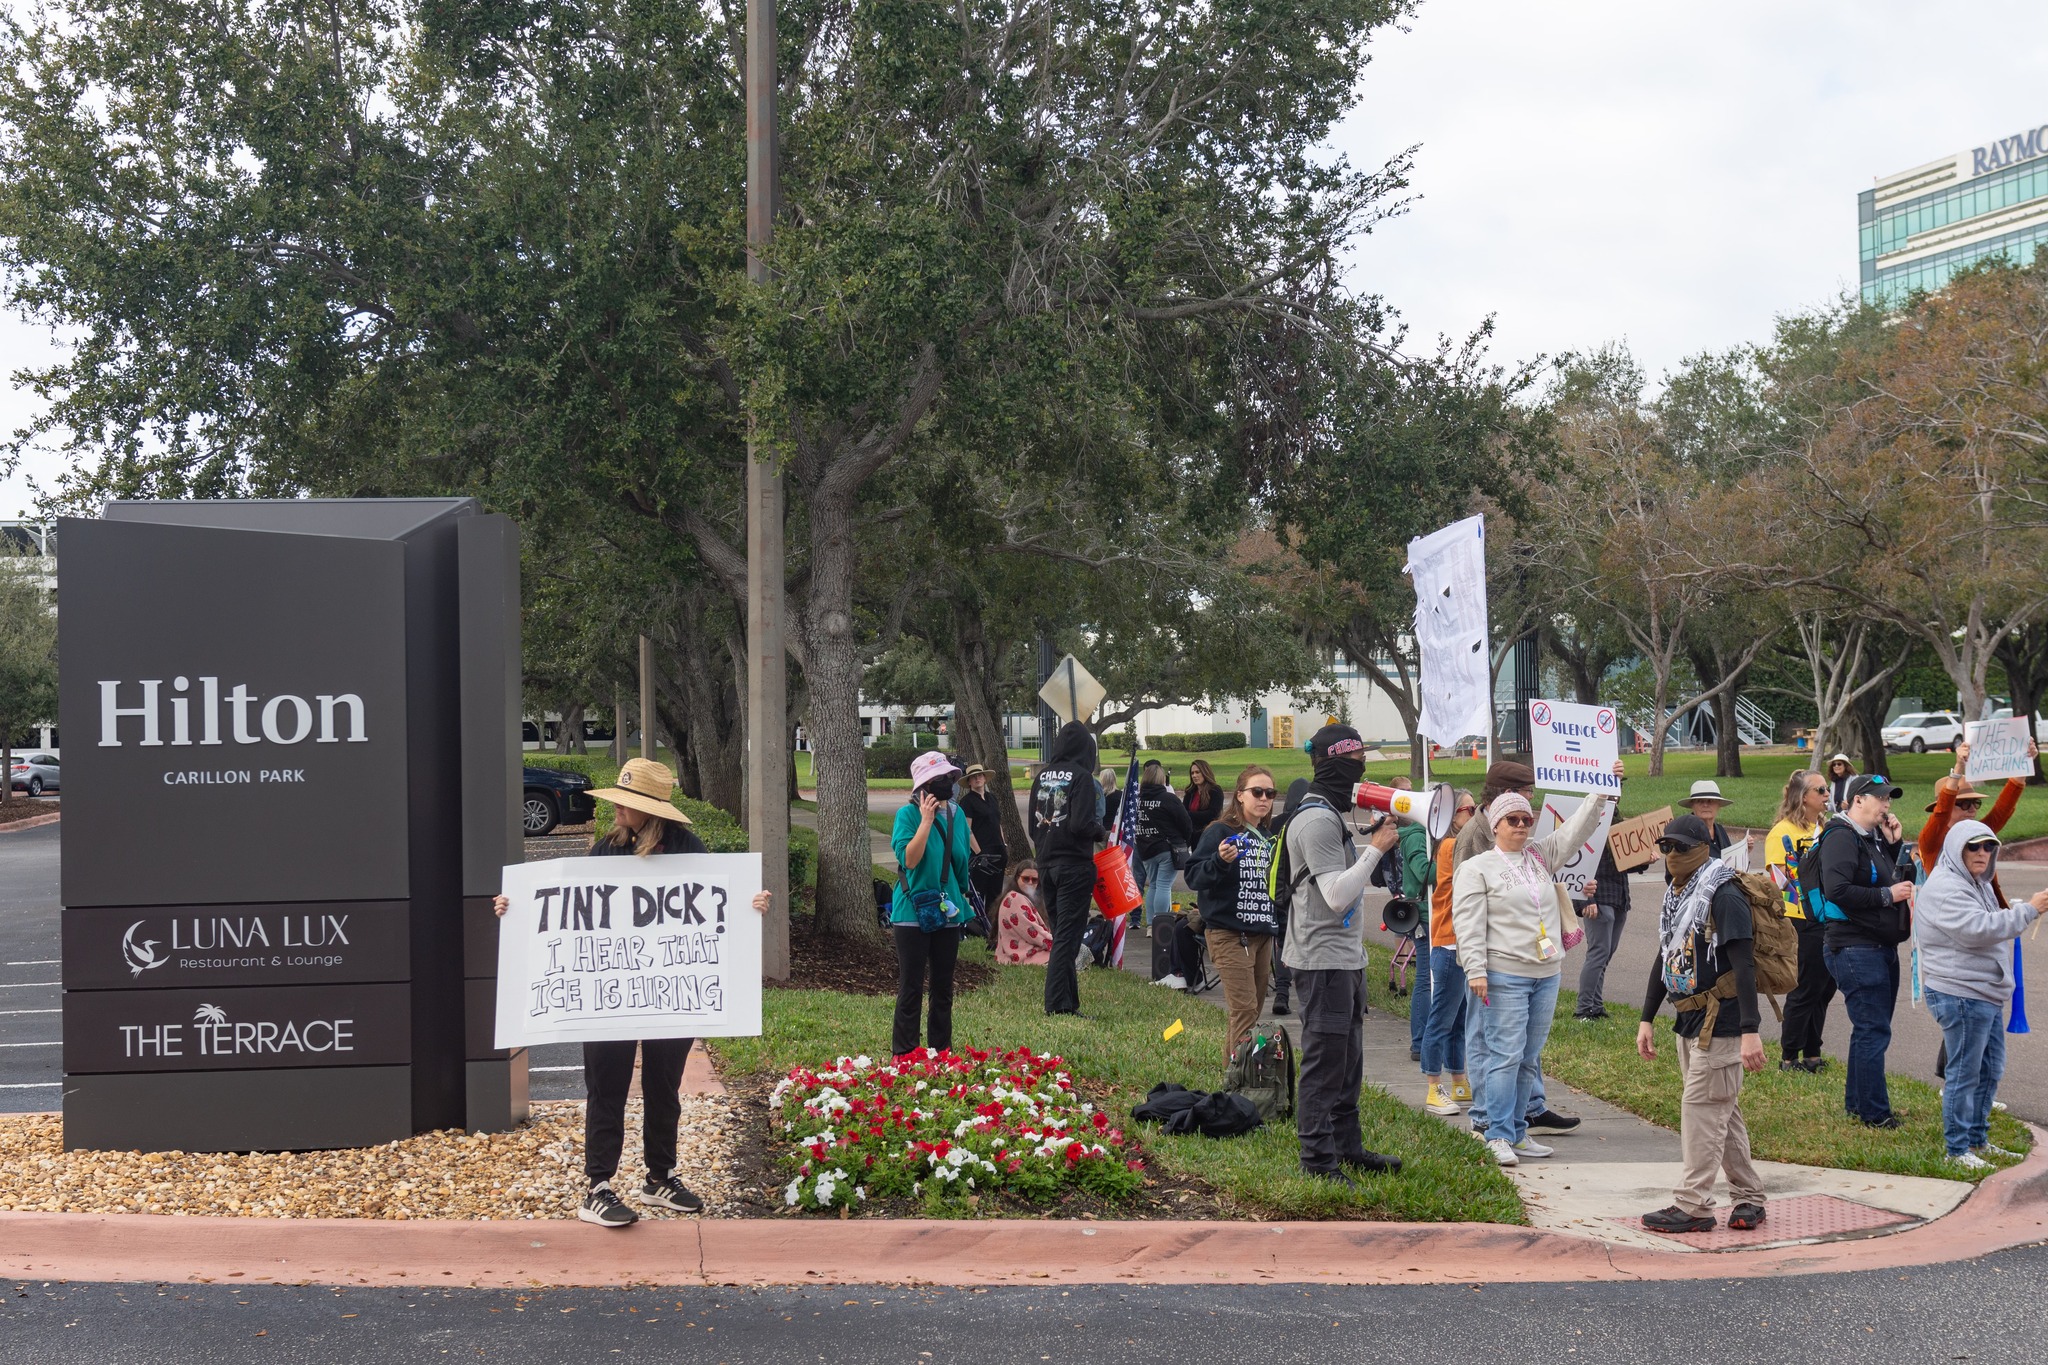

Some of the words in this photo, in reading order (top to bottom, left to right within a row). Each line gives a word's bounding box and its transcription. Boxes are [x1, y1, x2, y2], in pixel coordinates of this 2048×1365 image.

[97, 676, 369, 747] Hilton
[1551, 721, 1598, 739] SILENCE
[1970, 722, 2010, 744] THE
[1327, 738, 1363, 757] CHICAGO
[1970, 736, 2019, 764] WORLD
[1554, 754, 1600, 768] COMPLIANCE
[1970, 755, 2030, 777] WATCHING
[163, 770, 251, 785] CARILLON
[260, 769, 306, 783] PARK
[1039, 770, 1073, 782] CHAOS
[1537, 766, 1572, 783] FIGHT
[1574, 769, 1620, 788] FASCIST
[1611, 828, 1650, 860] FUCK
[1648, 818, 1674, 846] NAZ
[1240, 881, 1258, 891] you
[534, 884, 619, 934] TINY
[632, 882, 728, 934] DICK?
[1236, 900, 1259, 910] side
[1260, 902, 1271, 912] of
[172, 917, 270, 949] LUNA
[283, 915, 350, 947] LUX
[180, 956, 266, 969] Restaurant
[271, 955, 282, 966] &
[287, 954, 343, 967] Lounge
[544, 937, 565, 976] I
[572, 935, 654, 973] HEAR
[657, 932, 720, 967] THAT
[530, 977, 583, 1016] ICE
[594, 978, 623, 1011] IS
[627, 974, 723, 1012] HIRING
[119, 1024, 183, 1057] THE
[193, 1019, 354, 1055] TERRACE
